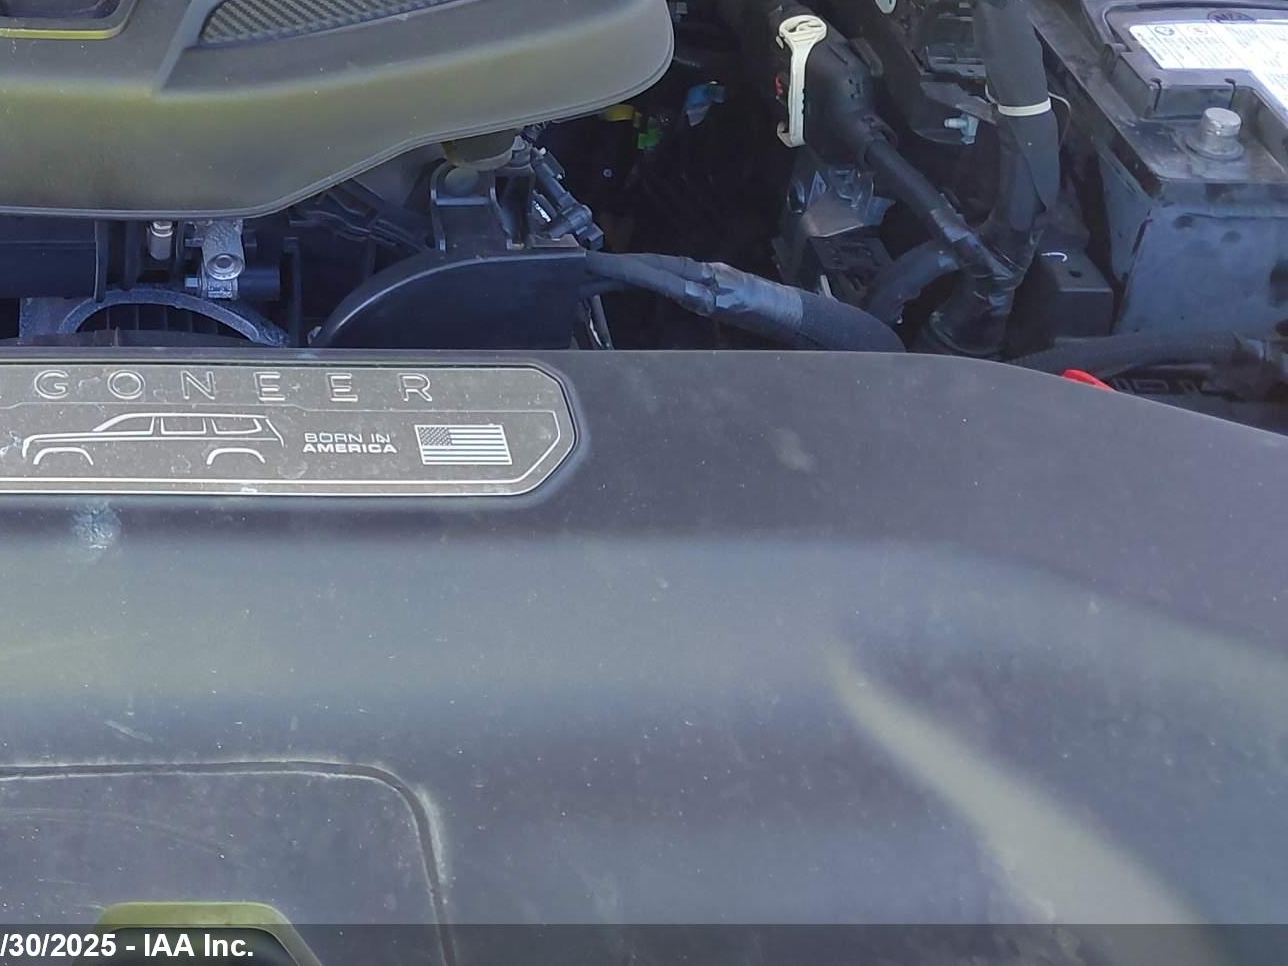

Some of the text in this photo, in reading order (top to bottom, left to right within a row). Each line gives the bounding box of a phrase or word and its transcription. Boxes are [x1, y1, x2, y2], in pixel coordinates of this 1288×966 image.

[304, 432, 391, 443] BORN IN
[302, 443, 398, 454] AMERICA
